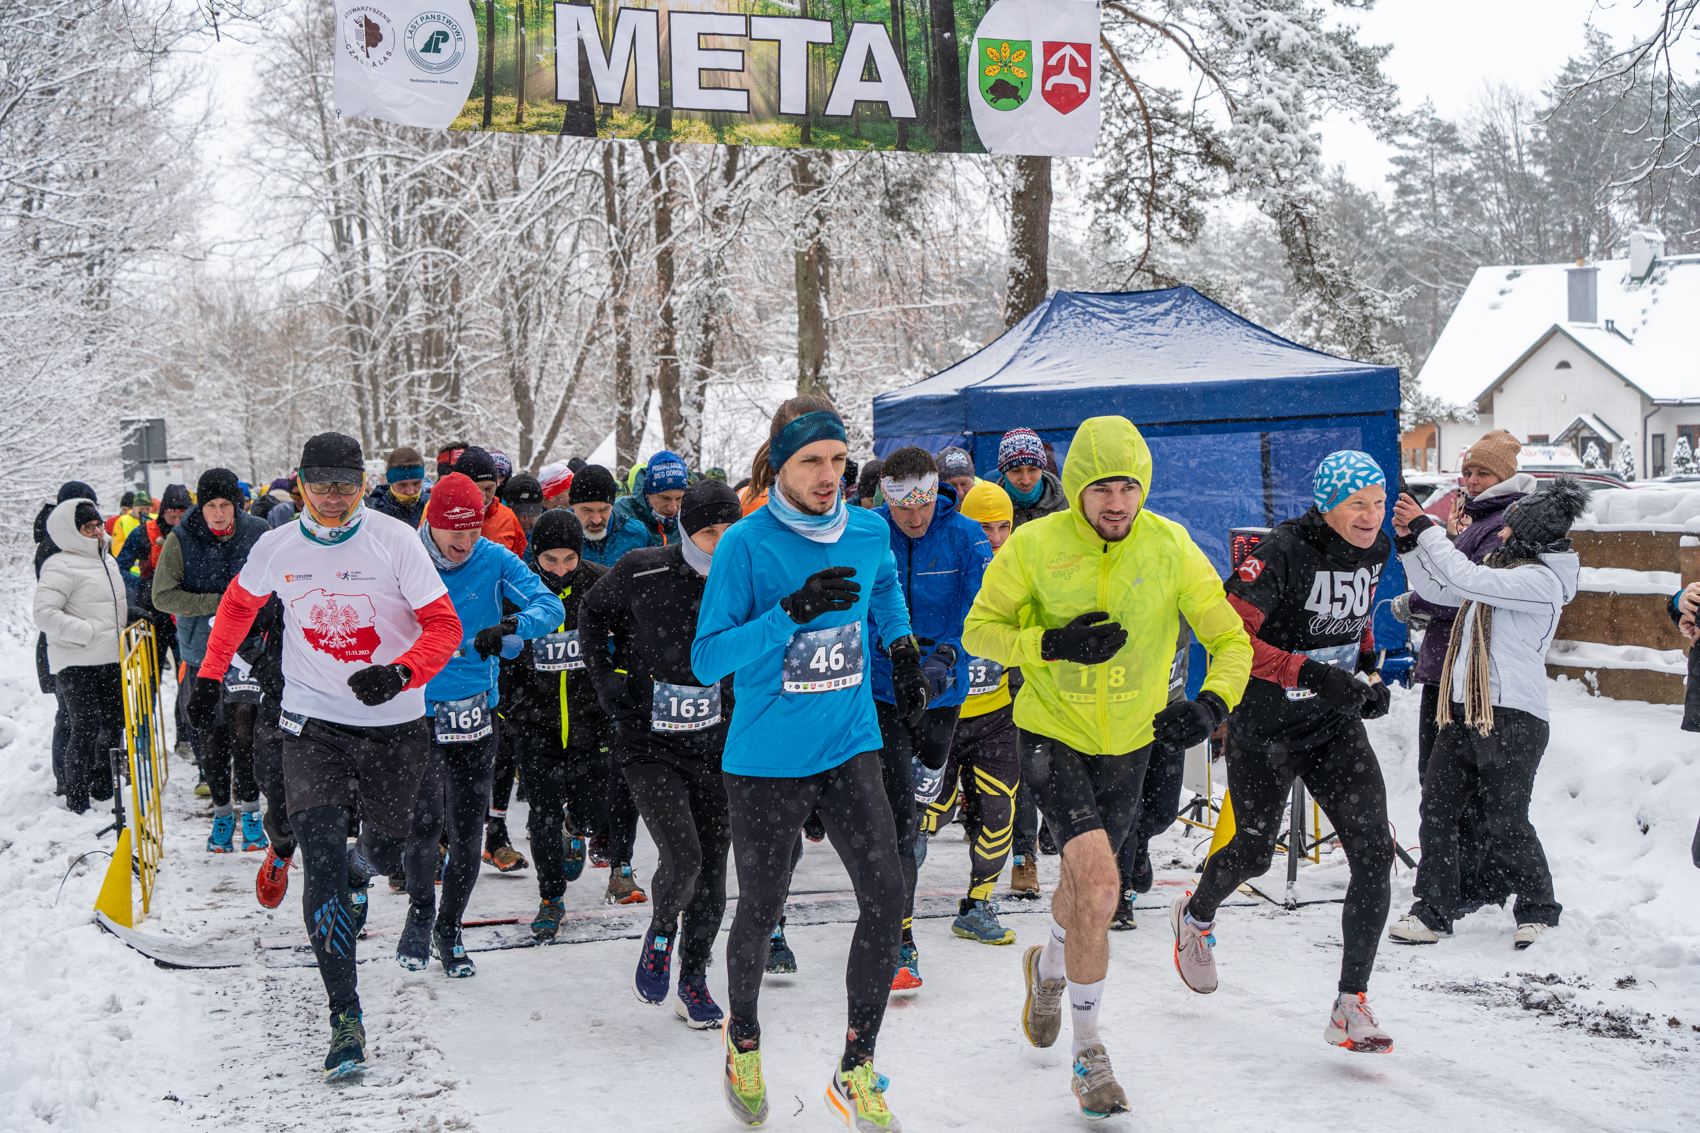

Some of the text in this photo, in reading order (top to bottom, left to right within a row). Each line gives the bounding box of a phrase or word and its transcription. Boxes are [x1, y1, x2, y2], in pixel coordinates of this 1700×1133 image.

[407, 20, 419, 39] LASY
[554, 2, 917, 119] META
[717, 508, 732, 517] 4F
[1304, 567, 1371, 620] 450
[546, 640, 580, 660] 170
[809, 641, 845, 673] 46
[448, 706, 482, 729] 169
[669, 696, 710, 718] 163
[1073, 1003, 1092, 1011] PUMA
